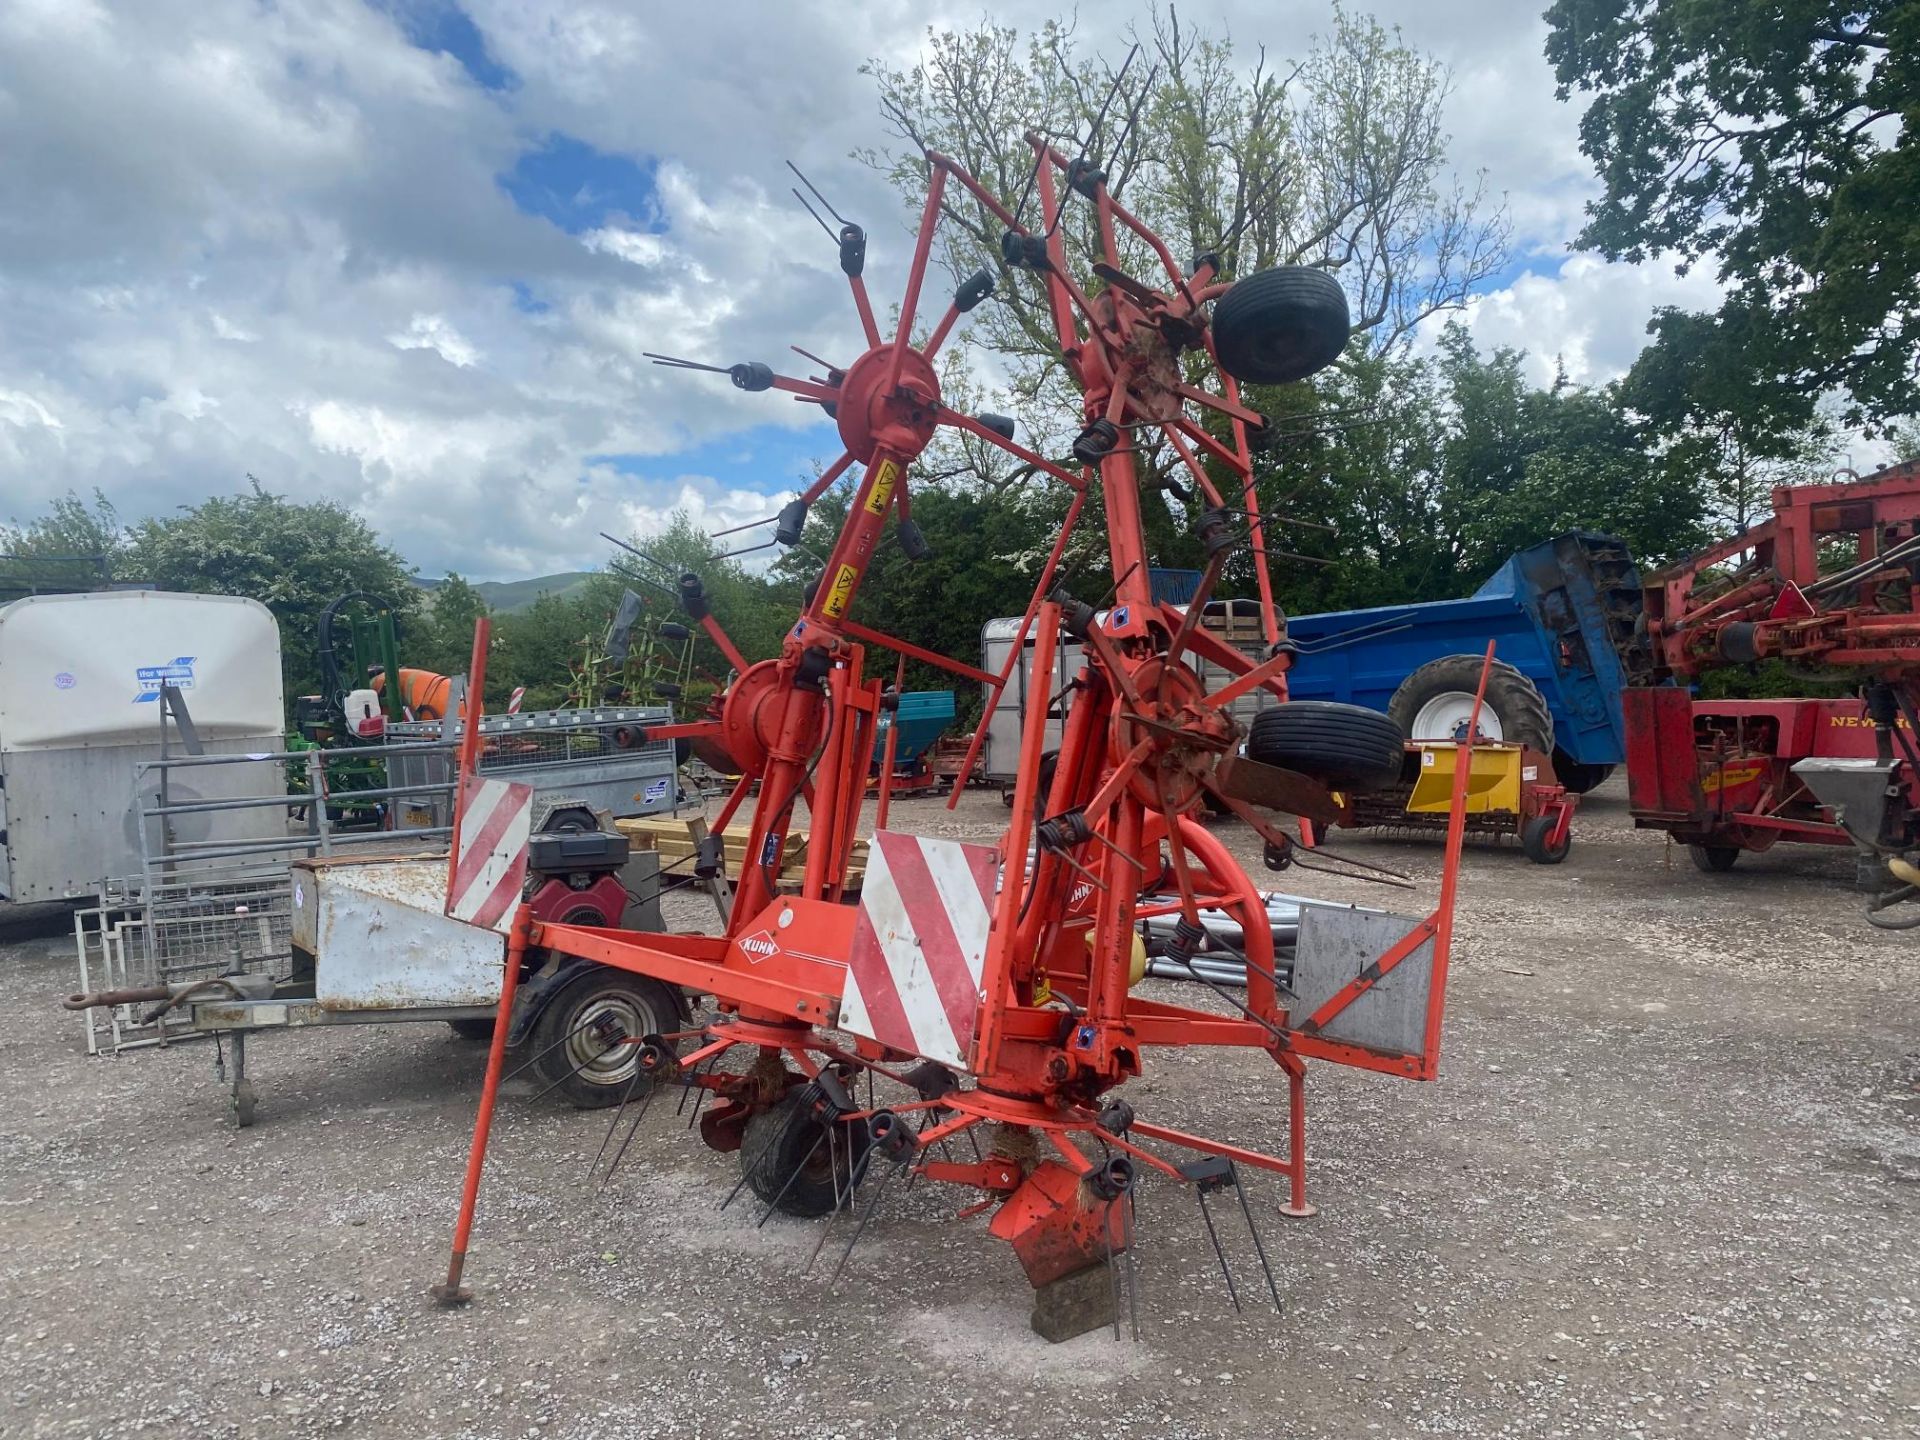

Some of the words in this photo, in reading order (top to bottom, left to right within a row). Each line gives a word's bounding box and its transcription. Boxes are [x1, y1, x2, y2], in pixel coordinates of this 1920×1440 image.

[139, 669, 154, 677] Ifor
[142, 680, 192, 689] Tralers
[743, 938, 775, 955] KUHN
